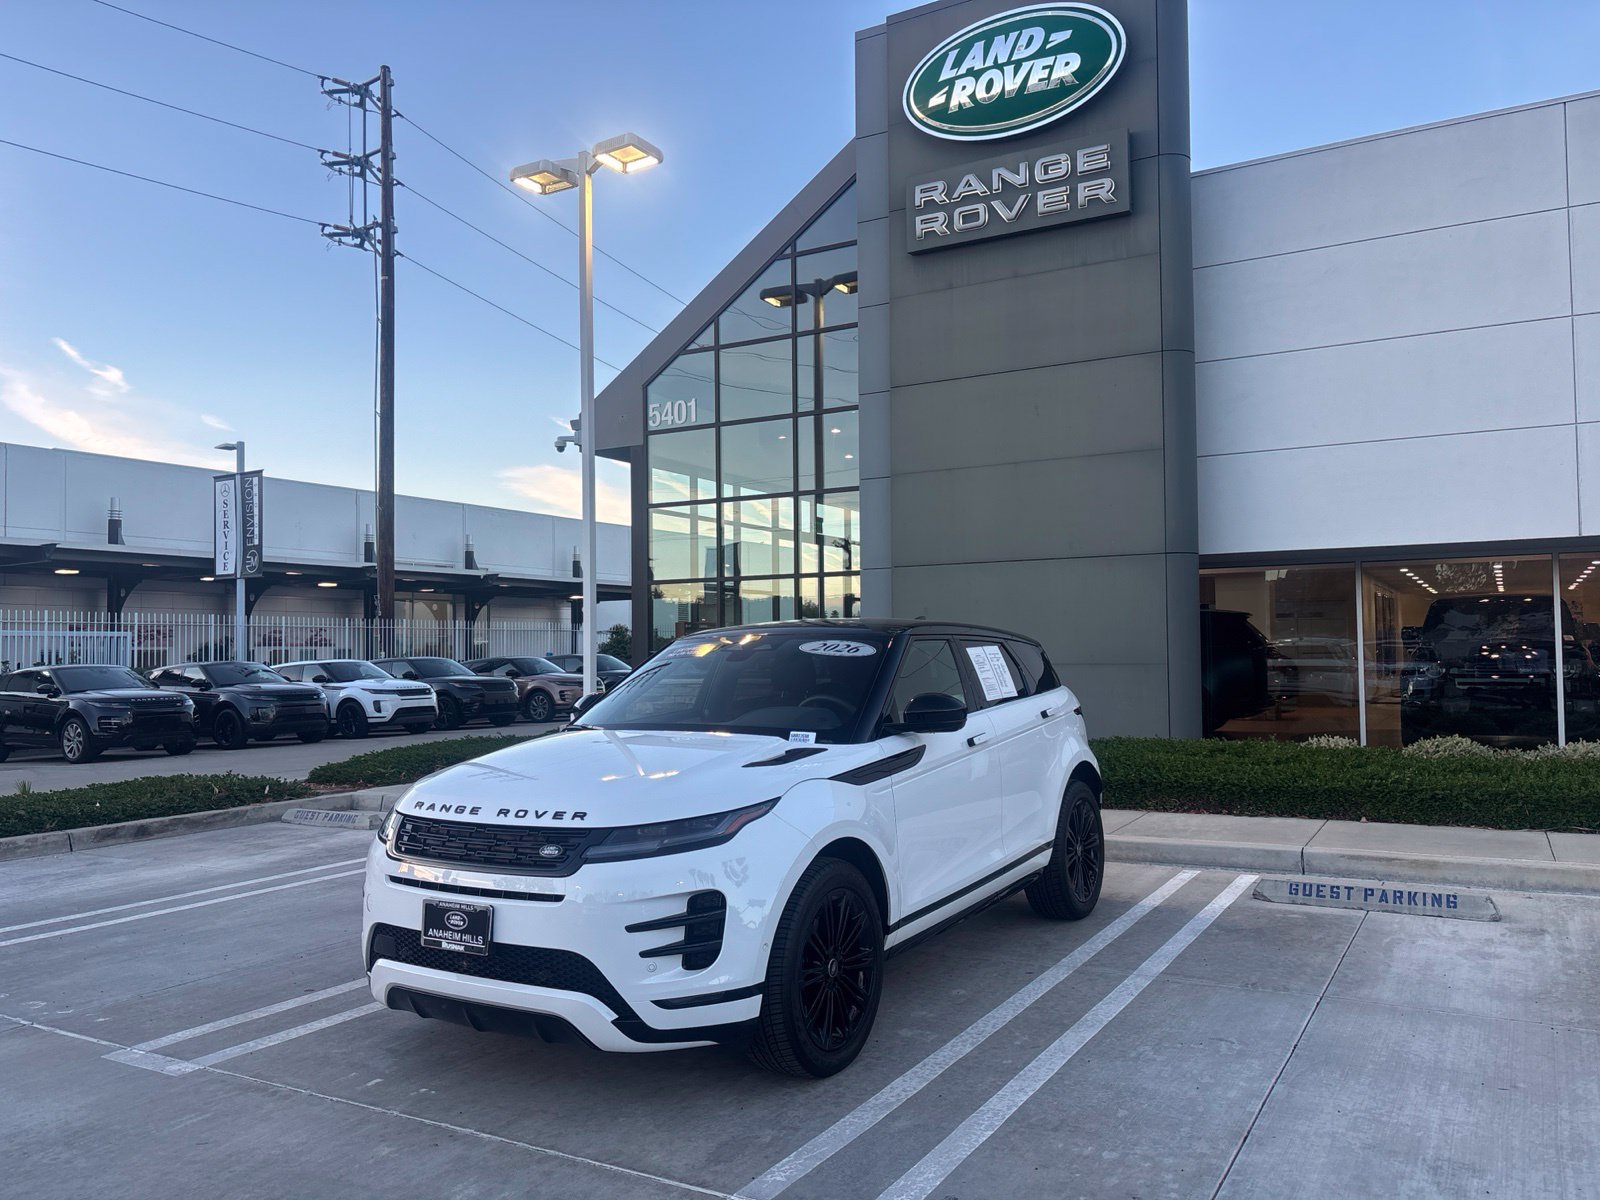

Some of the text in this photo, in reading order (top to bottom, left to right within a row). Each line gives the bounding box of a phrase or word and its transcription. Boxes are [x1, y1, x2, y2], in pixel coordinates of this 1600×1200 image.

[938, 26, 1045, 82] LAND
[947, 52, 1081, 114] ROVER
[914, 143, 1111, 209] RANGE
[915, 177, 1117, 240] ROVER
[648, 398, 697, 427] 5401
[245, 477, 253, 546] ENVISION
[809, 643, 863, 654] 2026
[293, 809, 359, 824] GUEST PARKING
[414, 801, 588, 821] RANGE ROVER
[1288, 882, 1458, 909] GUEST PARKING
[428, 928, 482, 944] ANAHEIM HILLS
